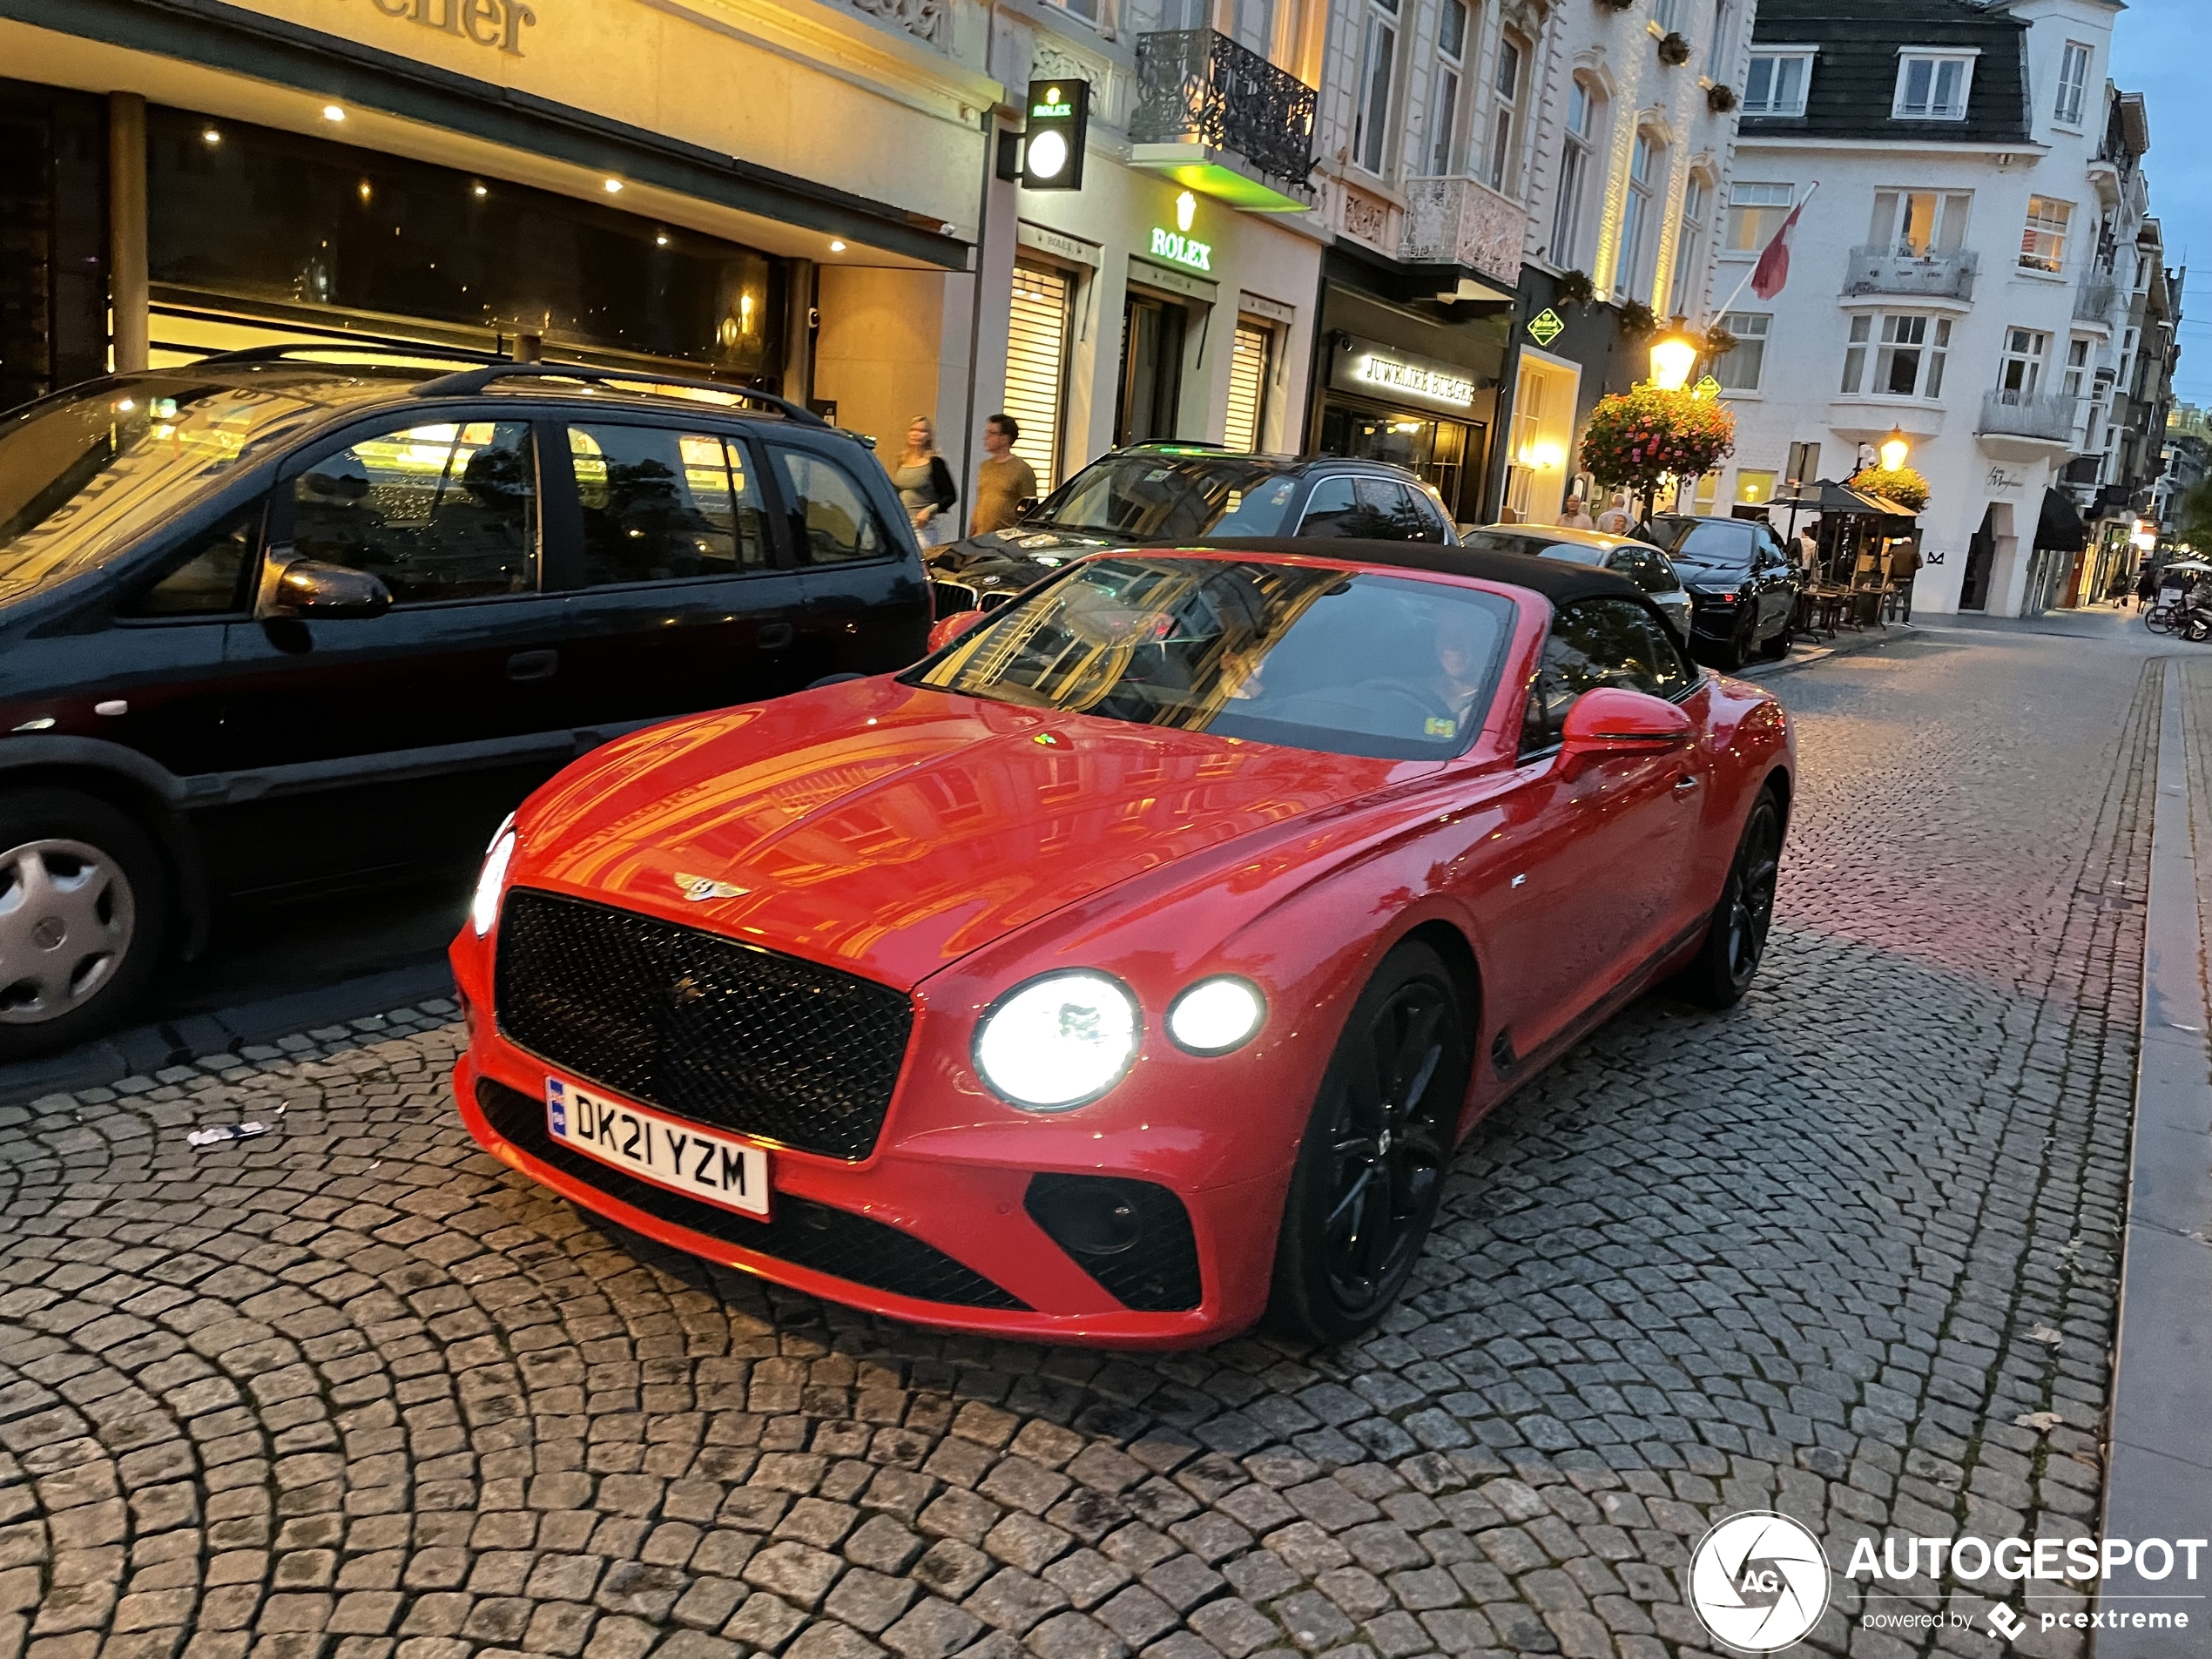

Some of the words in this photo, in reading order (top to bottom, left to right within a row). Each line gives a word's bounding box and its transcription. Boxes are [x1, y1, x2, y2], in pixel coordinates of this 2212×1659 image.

[1150, 226, 1211, 272] ROLEX
[1366, 357, 1428, 392] JUWELIER
[1431, 374, 1476, 404] BURGER
[576, 1094, 652, 1165] DK21
[665, 1129, 745, 1197] YZM
